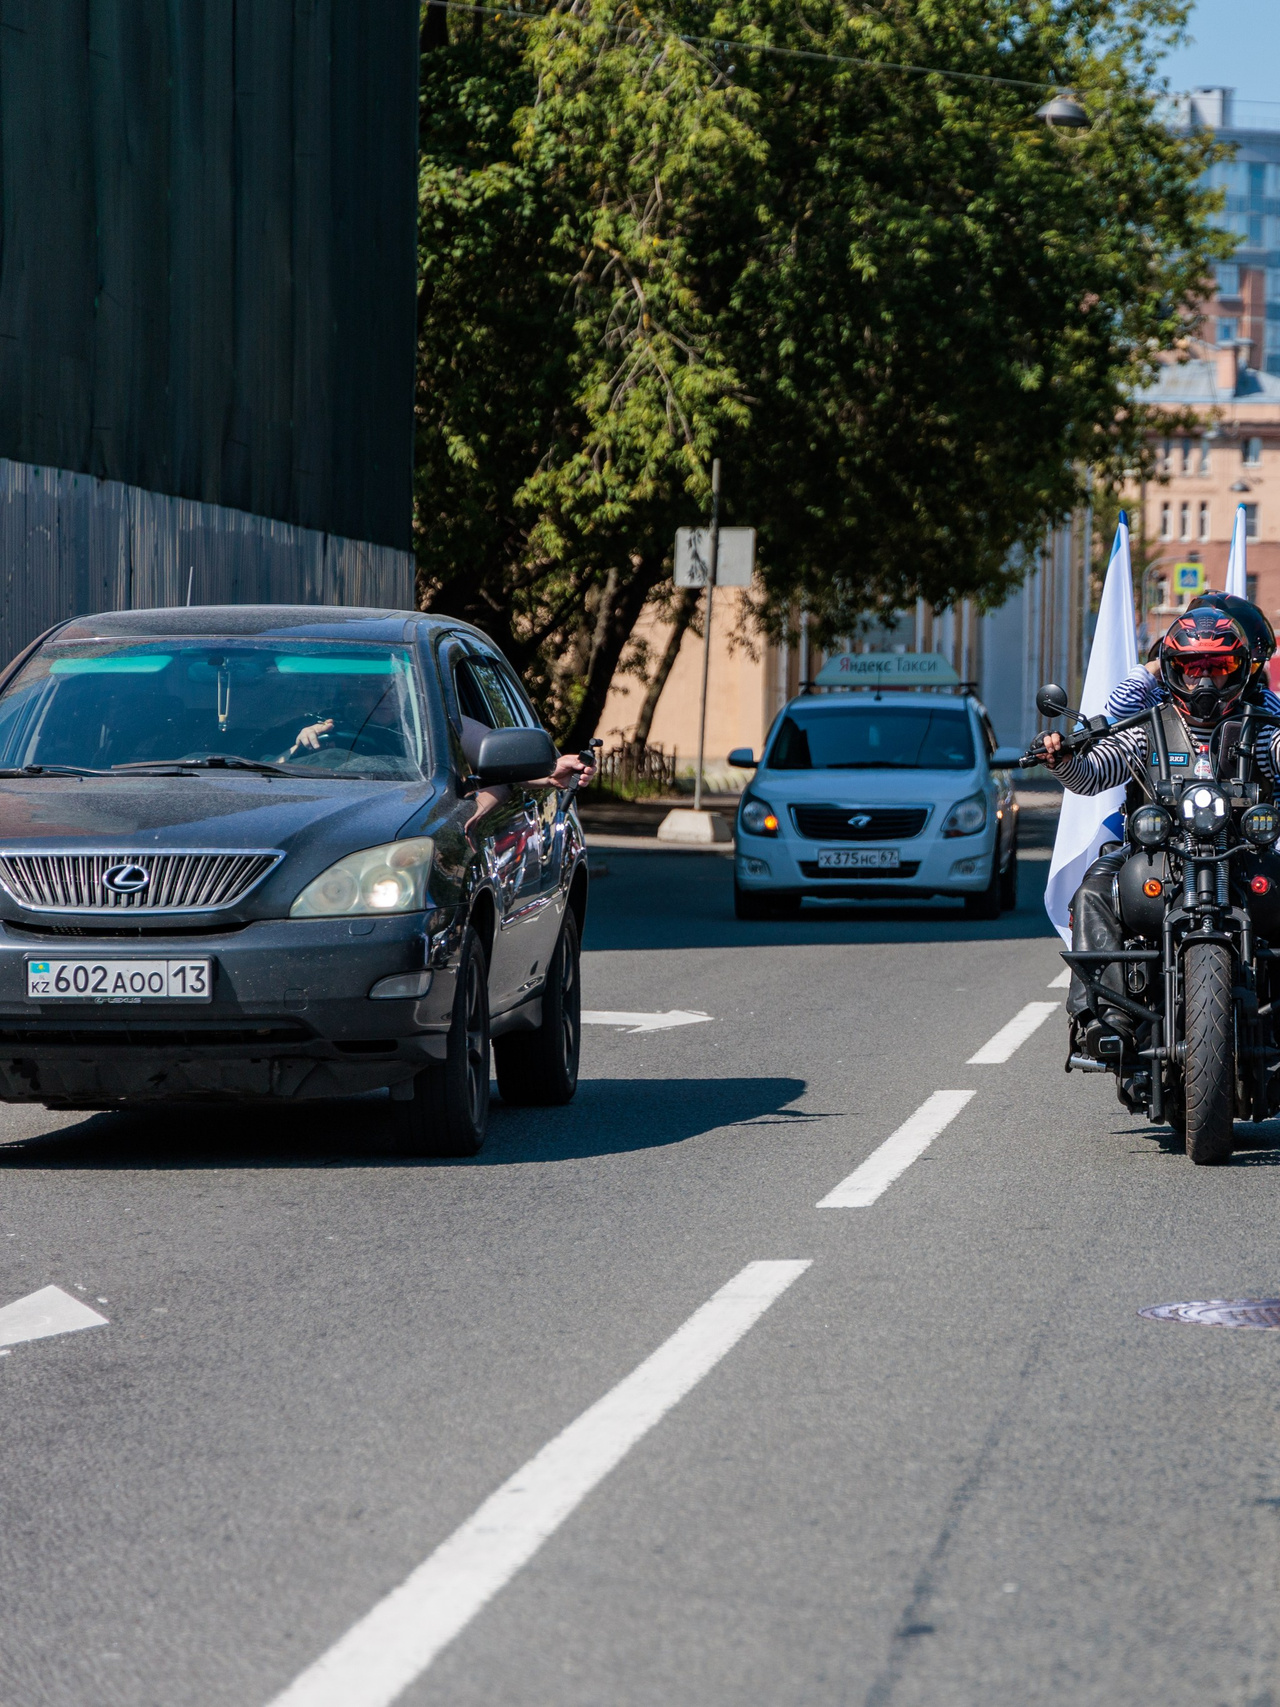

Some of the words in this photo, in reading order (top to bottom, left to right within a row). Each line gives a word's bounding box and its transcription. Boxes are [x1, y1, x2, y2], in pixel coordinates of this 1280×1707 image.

[840, 657, 891, 673] Яндекс
[897, 657, 936, 672] Такси
[880, 852, 894, 861] 67
[171, 965, 206, 993] 13
[31, 981, 50, 993] KZ
